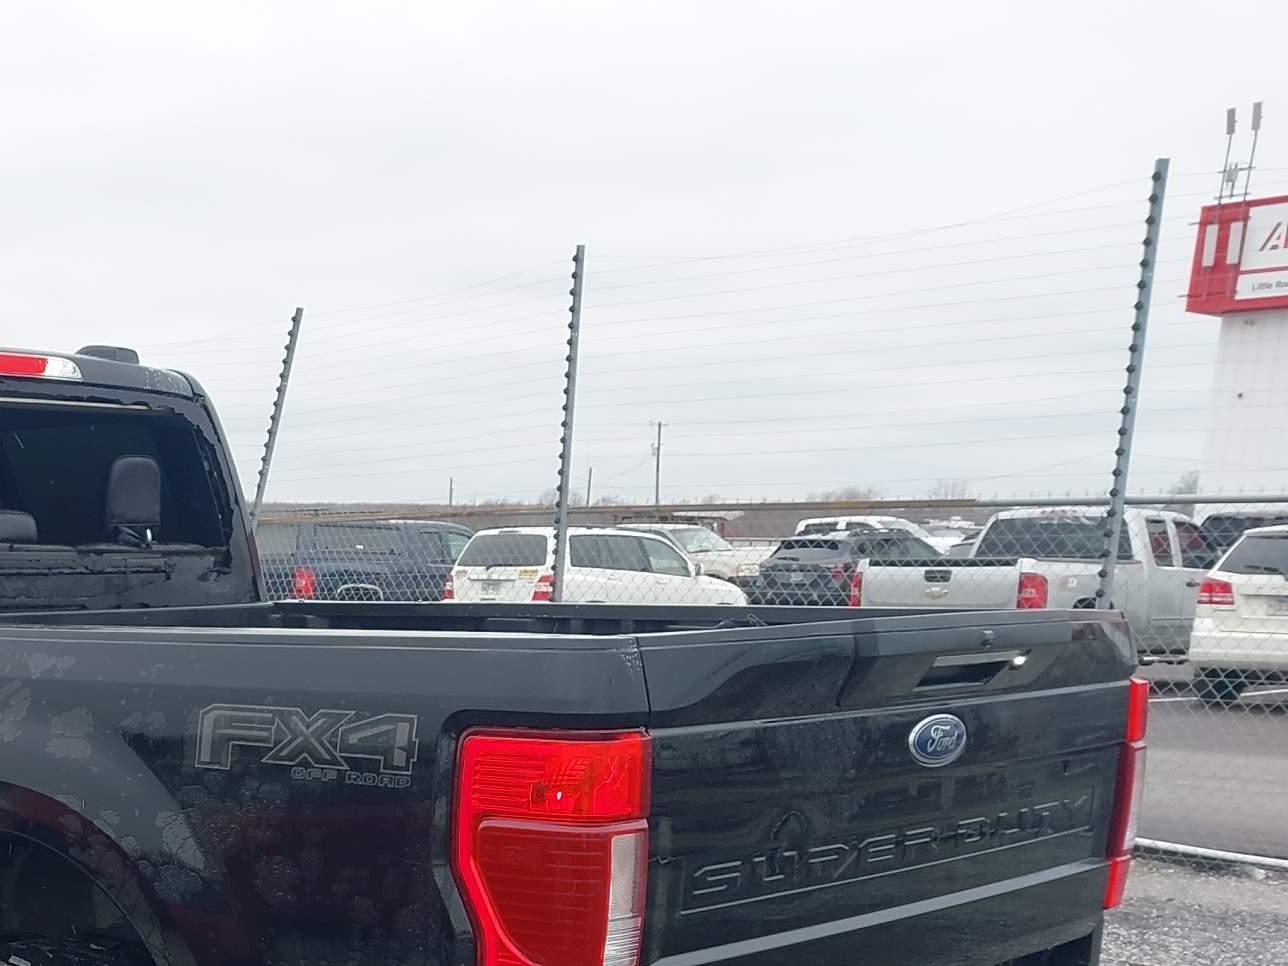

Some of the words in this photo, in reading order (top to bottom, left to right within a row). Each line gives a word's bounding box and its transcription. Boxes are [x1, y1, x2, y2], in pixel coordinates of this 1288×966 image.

[1251, 283, 1273, 291] Little
[195, 703, 419, 775] FX4
[927, 725, 958, 753] Ford
[290, 767, 337, 782] OFF
[345, 772, 411, 788] ROAD
[692, 826, 944, 897] SUPER
[948, 794, 1089, 844] DUTY
